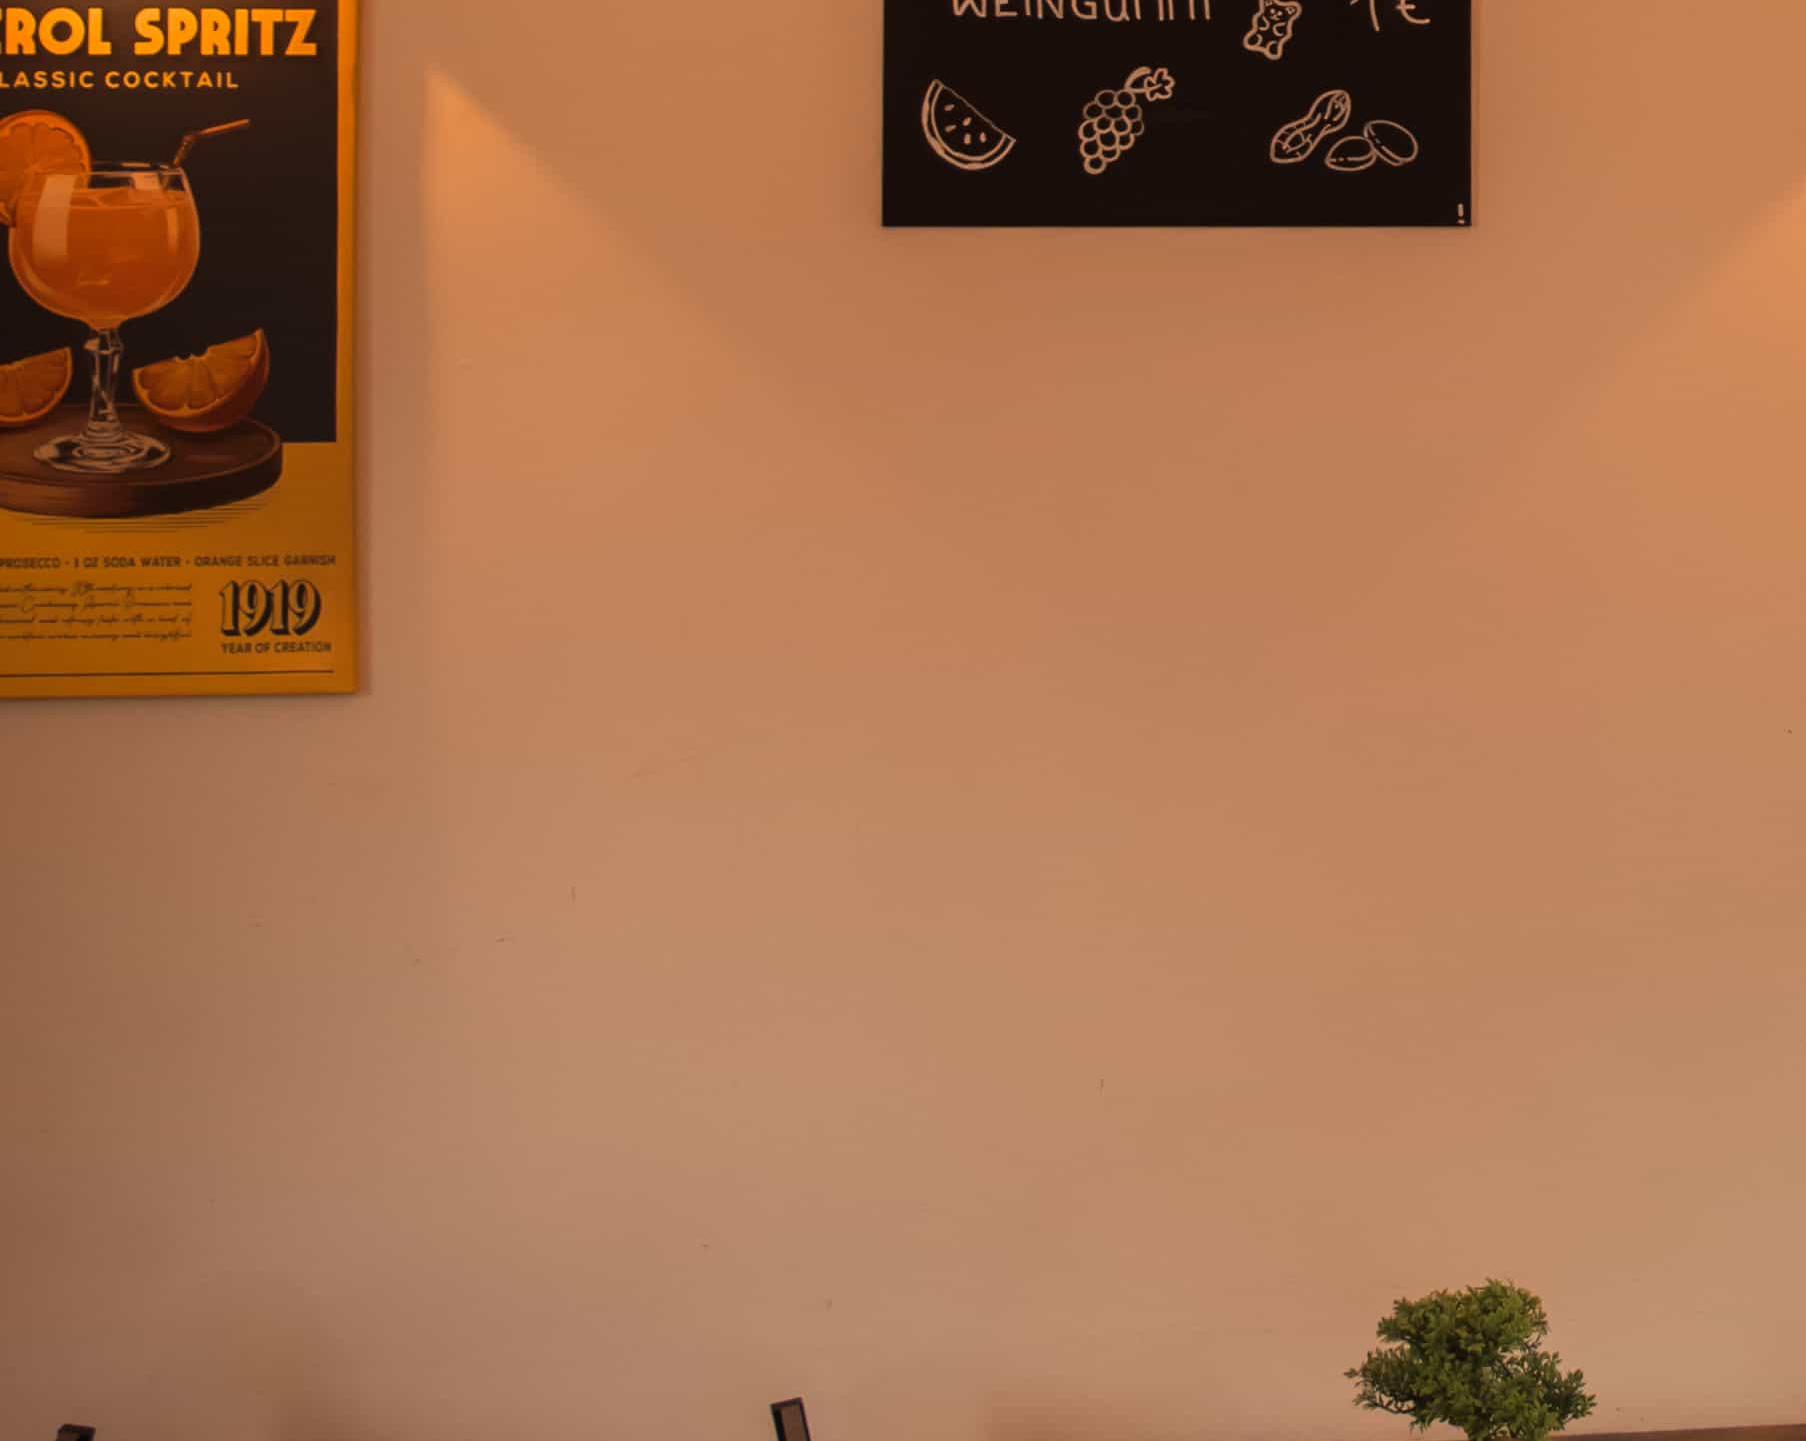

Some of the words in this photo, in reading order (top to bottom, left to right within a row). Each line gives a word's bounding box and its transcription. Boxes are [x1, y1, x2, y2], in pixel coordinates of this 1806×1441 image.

[0, 7, 112, 55] ROL
[134, 7, 318, 56] SPRITZ
[104, 71, 239, 89] COCKTAIL
[83, 556, 98, 568] OZ
[103, 556, 136, 568] SODA
[140, 555, 181, 568] WATER
[194, 555, 242, 567] ORANGE
[247, 554, 279, 567] SLICE
[219, 579, 322, 637] 1919
[222, 642, 252, 654] YEAR
[254, 642, 270, 654] OF
[274, 641, 332, 653] CREATION
